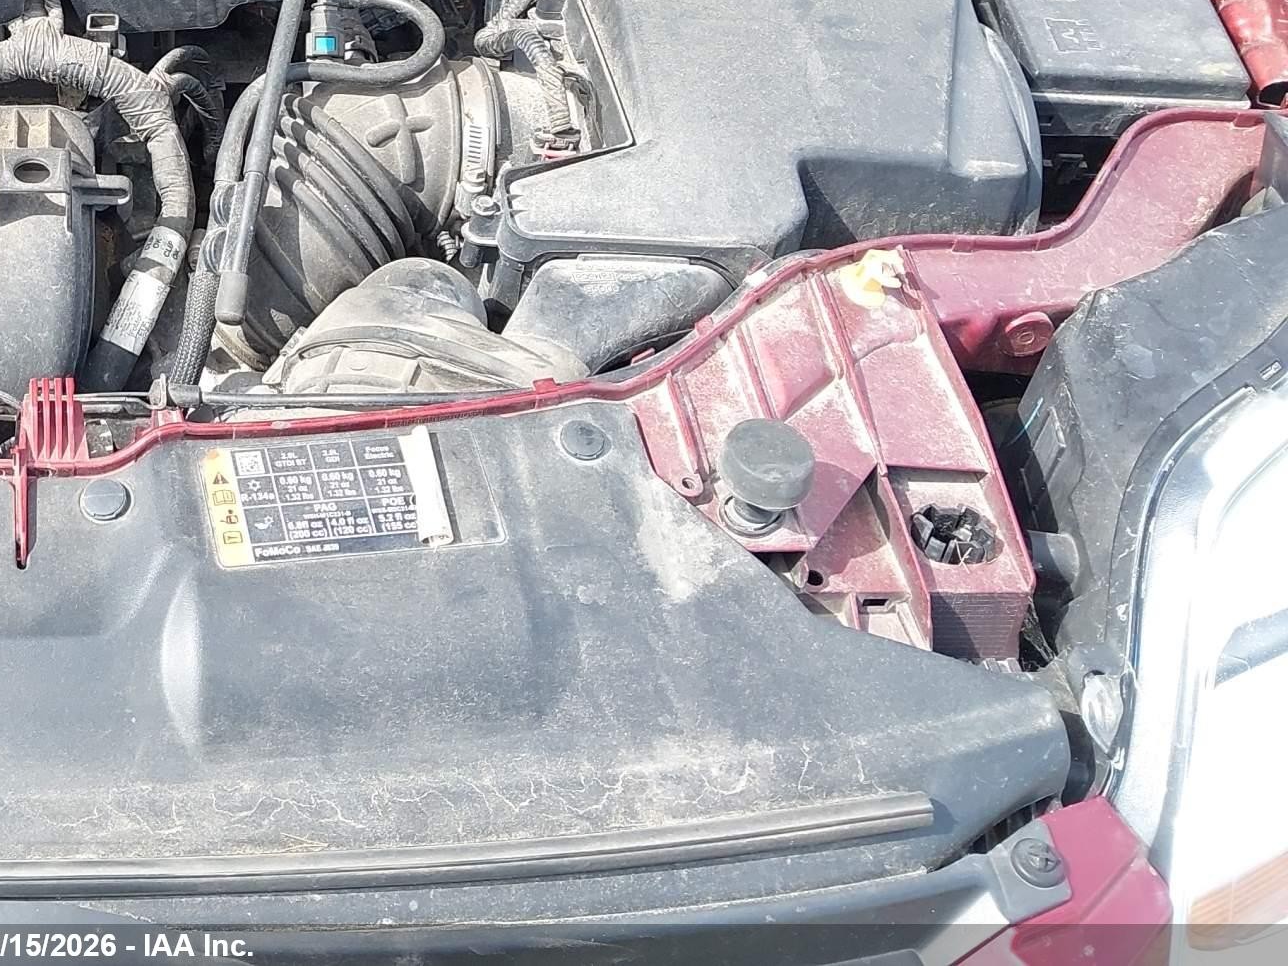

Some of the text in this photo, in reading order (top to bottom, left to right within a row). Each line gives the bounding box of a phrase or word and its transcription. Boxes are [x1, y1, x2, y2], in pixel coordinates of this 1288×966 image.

[388, 468, 402, 478] kg
[376, 478, 386, 486] 21
[241, 492, 275, 503] R-134a
[382, 496, 406, 507] POE
[313, 502, 338, 513] PAG
[356, 517, 370, 525] oz
[378, 513, 394, 523] 5.2
[394, 512, 403, 521] fl
[333, 524, 373, 537] (120 cc)
[254, 544, 301, 557] FoMoCo
